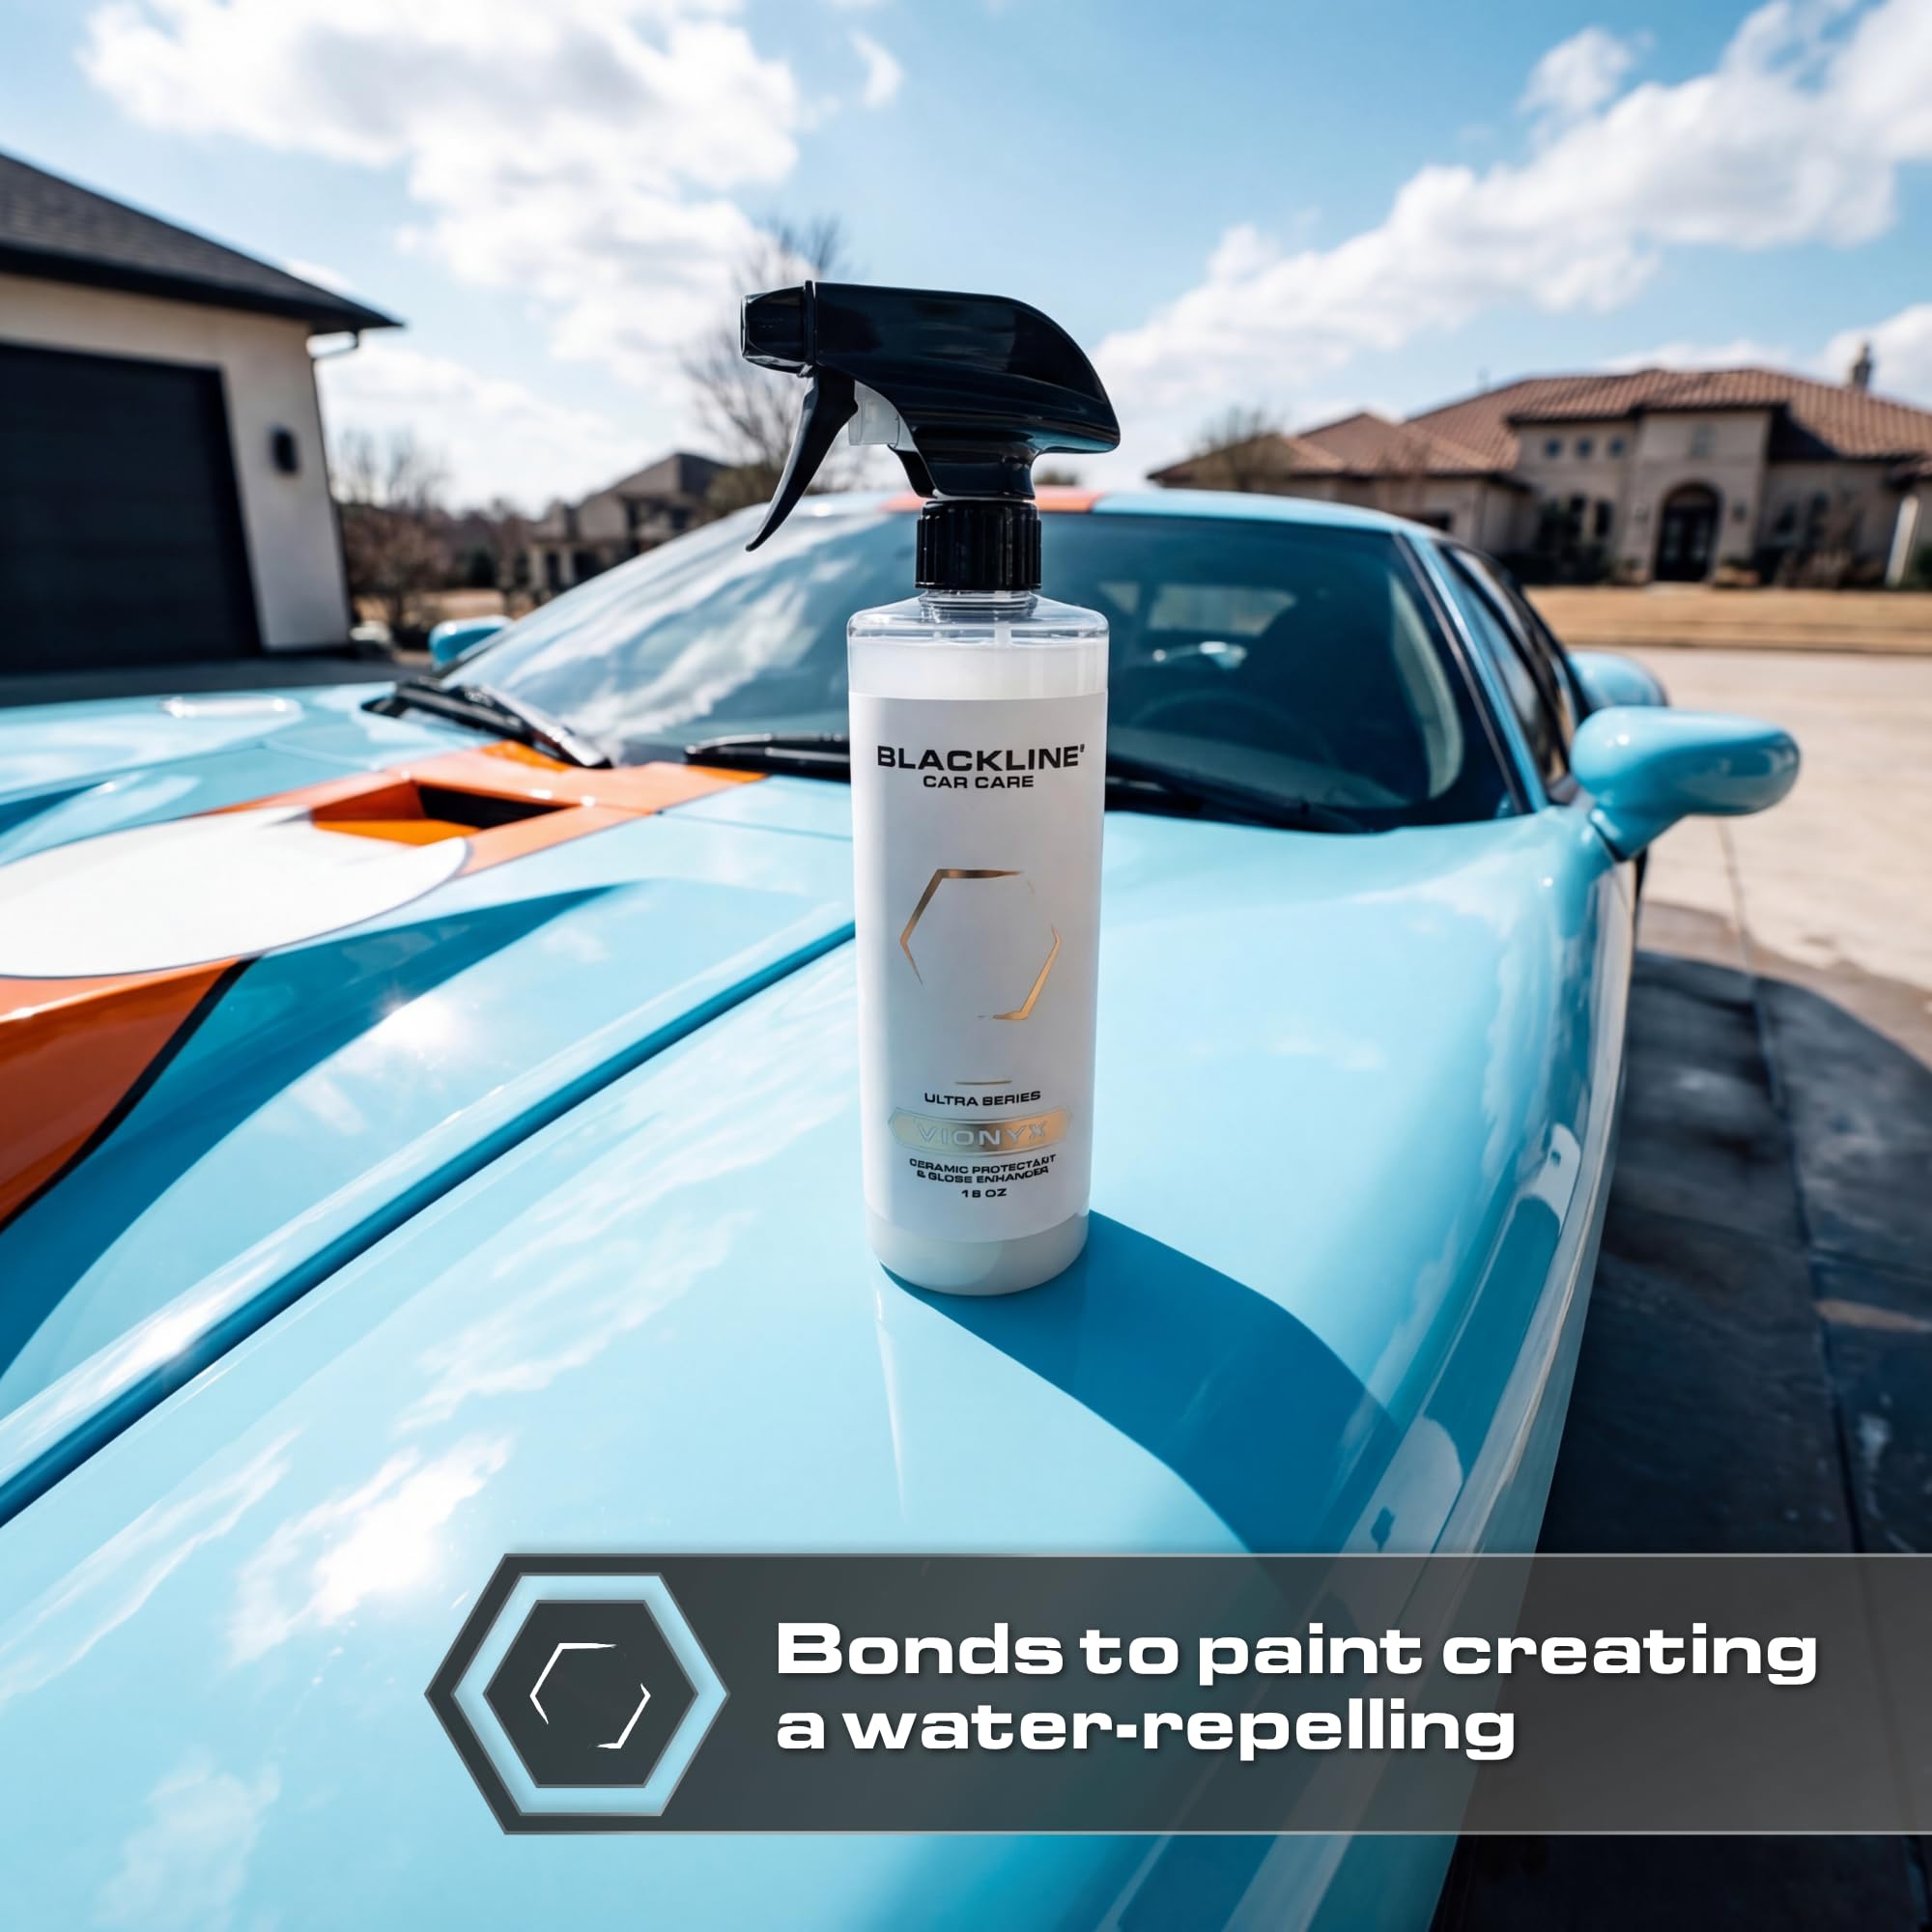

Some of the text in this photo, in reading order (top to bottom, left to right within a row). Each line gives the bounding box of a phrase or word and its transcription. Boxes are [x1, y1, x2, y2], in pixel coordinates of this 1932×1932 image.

[923, 775, 1035, 789] CAR CARE
[924, 1091, 1041, 1106] ULTRA SERIES
[919, 1122, 1047, 1147] VIONYX
[909, 1157, 969, 1175] CERAMIC
[984, 1188, 1008, 1199] OZ
